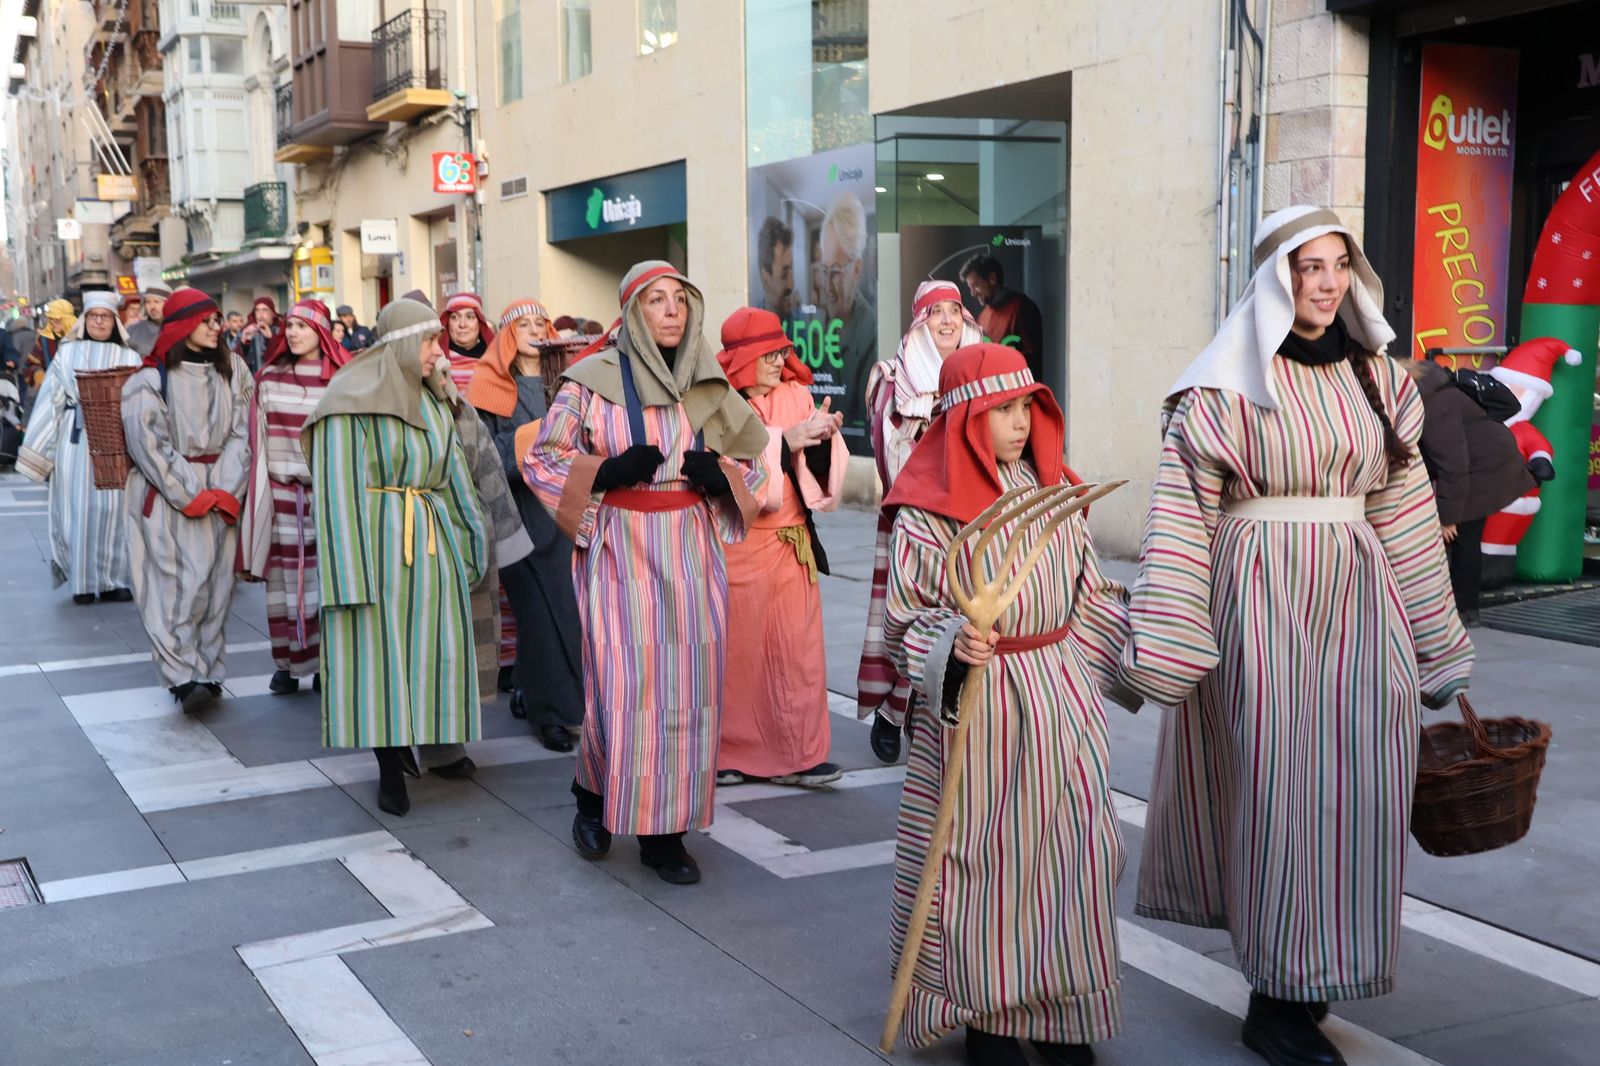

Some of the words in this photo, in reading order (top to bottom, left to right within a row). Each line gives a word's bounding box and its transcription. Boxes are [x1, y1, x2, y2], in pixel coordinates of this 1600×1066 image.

[1456, 146, 1481, 155] MODA
[1482, 147, 1508, 157] TEXTIL
[603, 194, 641, 225] Unicaja
[368, 233, 391, 241] Lowi
[1004, 238, 1031, 248] Unicaja
[783, 319, 844, 369] 50€
